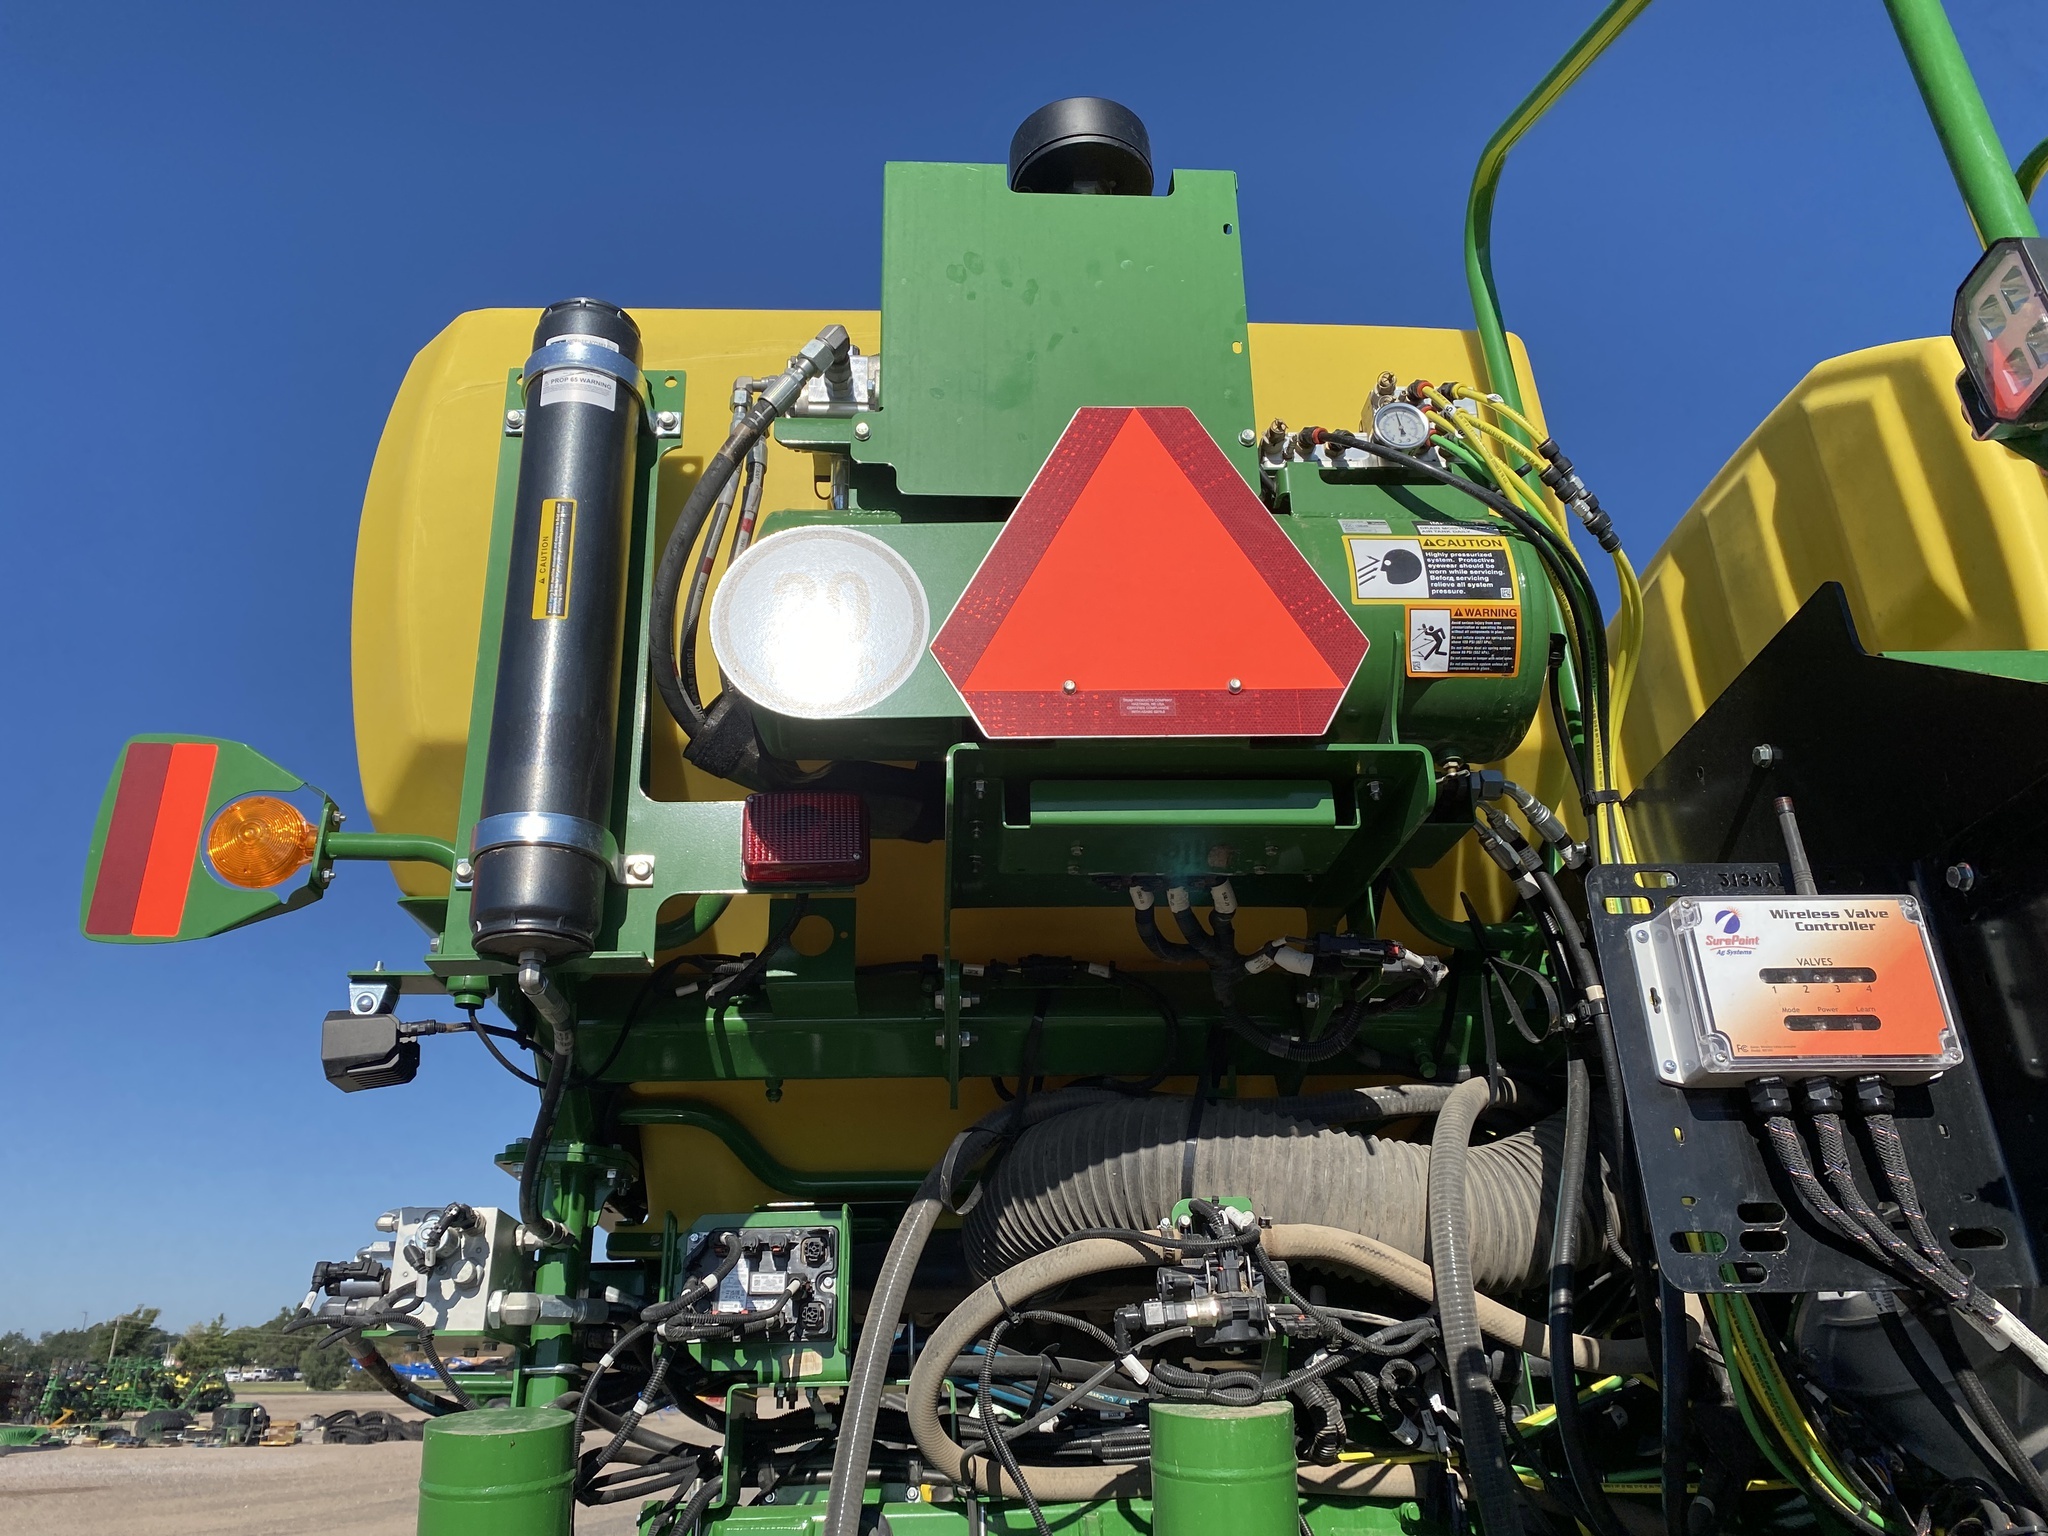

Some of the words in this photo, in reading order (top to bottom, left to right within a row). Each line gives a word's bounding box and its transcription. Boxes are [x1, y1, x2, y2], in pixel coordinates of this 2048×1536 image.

[580, 378, 612, 390] WARNING
[540, 536, 549, 574] CAUTION
[1464, 608, 1517, 617] WARNING
[1769, 909, 1840, 919] Wireless
[1844, 909, 1889, 919] Valve
[1795, 922, 1876, 931] Controller
[1706, 935, 1759, 946] SurePoint
[1796, 958, 1833, 966] VALVES
